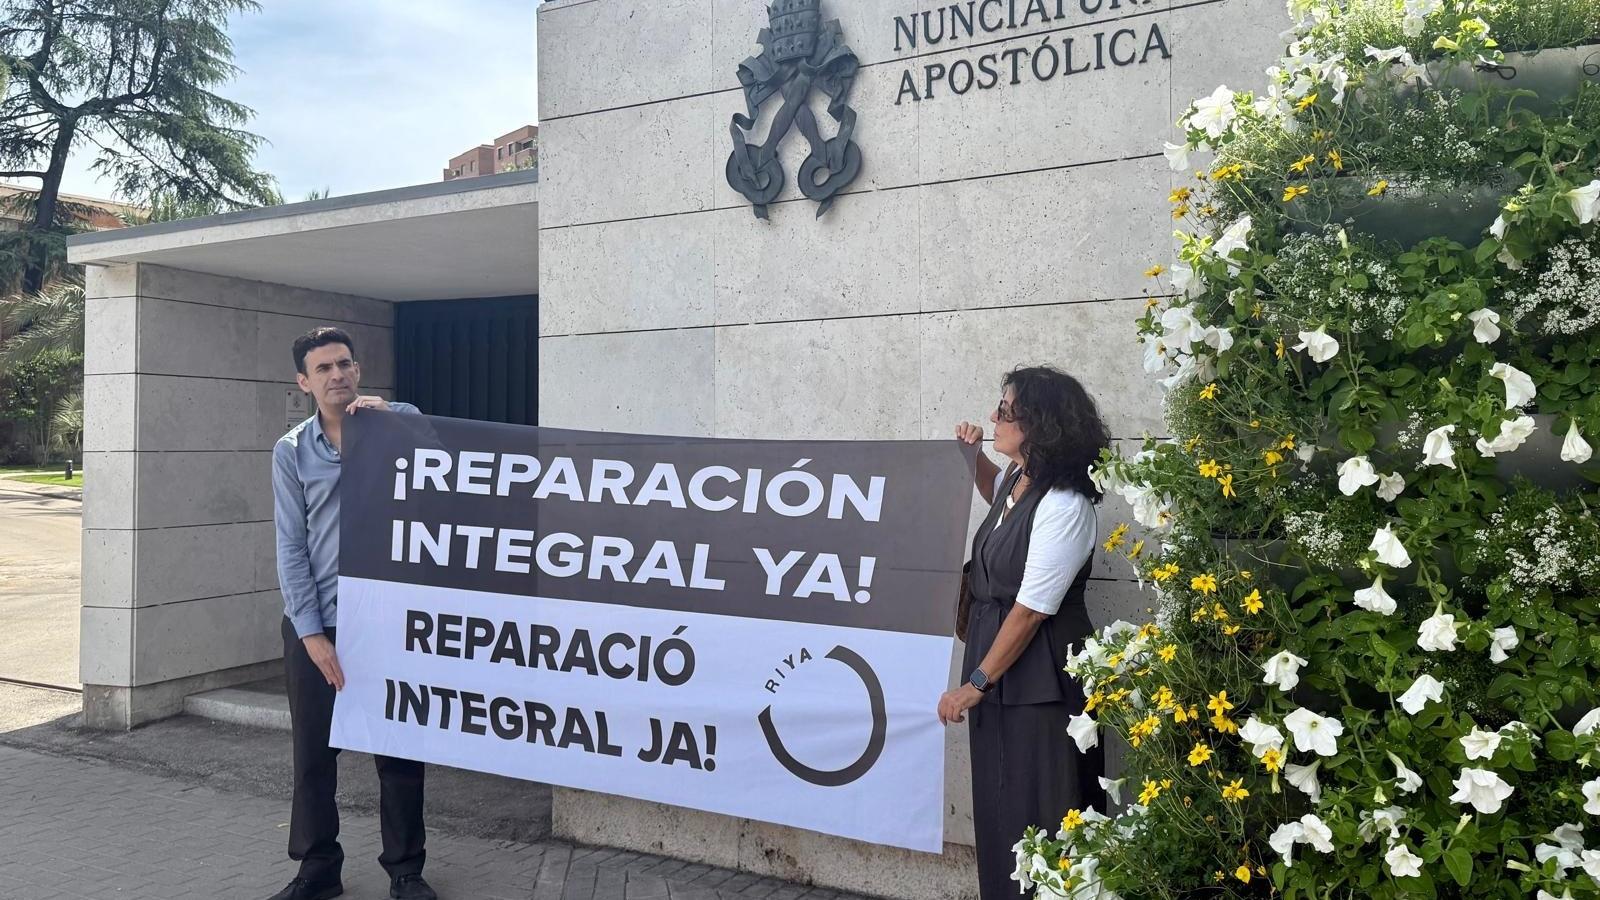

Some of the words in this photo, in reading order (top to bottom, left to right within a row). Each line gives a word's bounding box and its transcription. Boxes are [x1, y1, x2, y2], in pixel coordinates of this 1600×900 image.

[893, 0, 1151, 52] NUNCIA
[894, 22, 1173, 106] APOSTÓLICA
[393, 447, 886, 523] ¡REPARACIÓN
[391, 519, 726, 591] INTEGRAL
[752, 547, 877, 604] YA!
[405, 609, 696, 687] REPARACIÓ
[764, 647, 813, 694] RIYA
[384, 678, 623, 758] INTEGRAL
[637, 717, 717, 772] JA!
